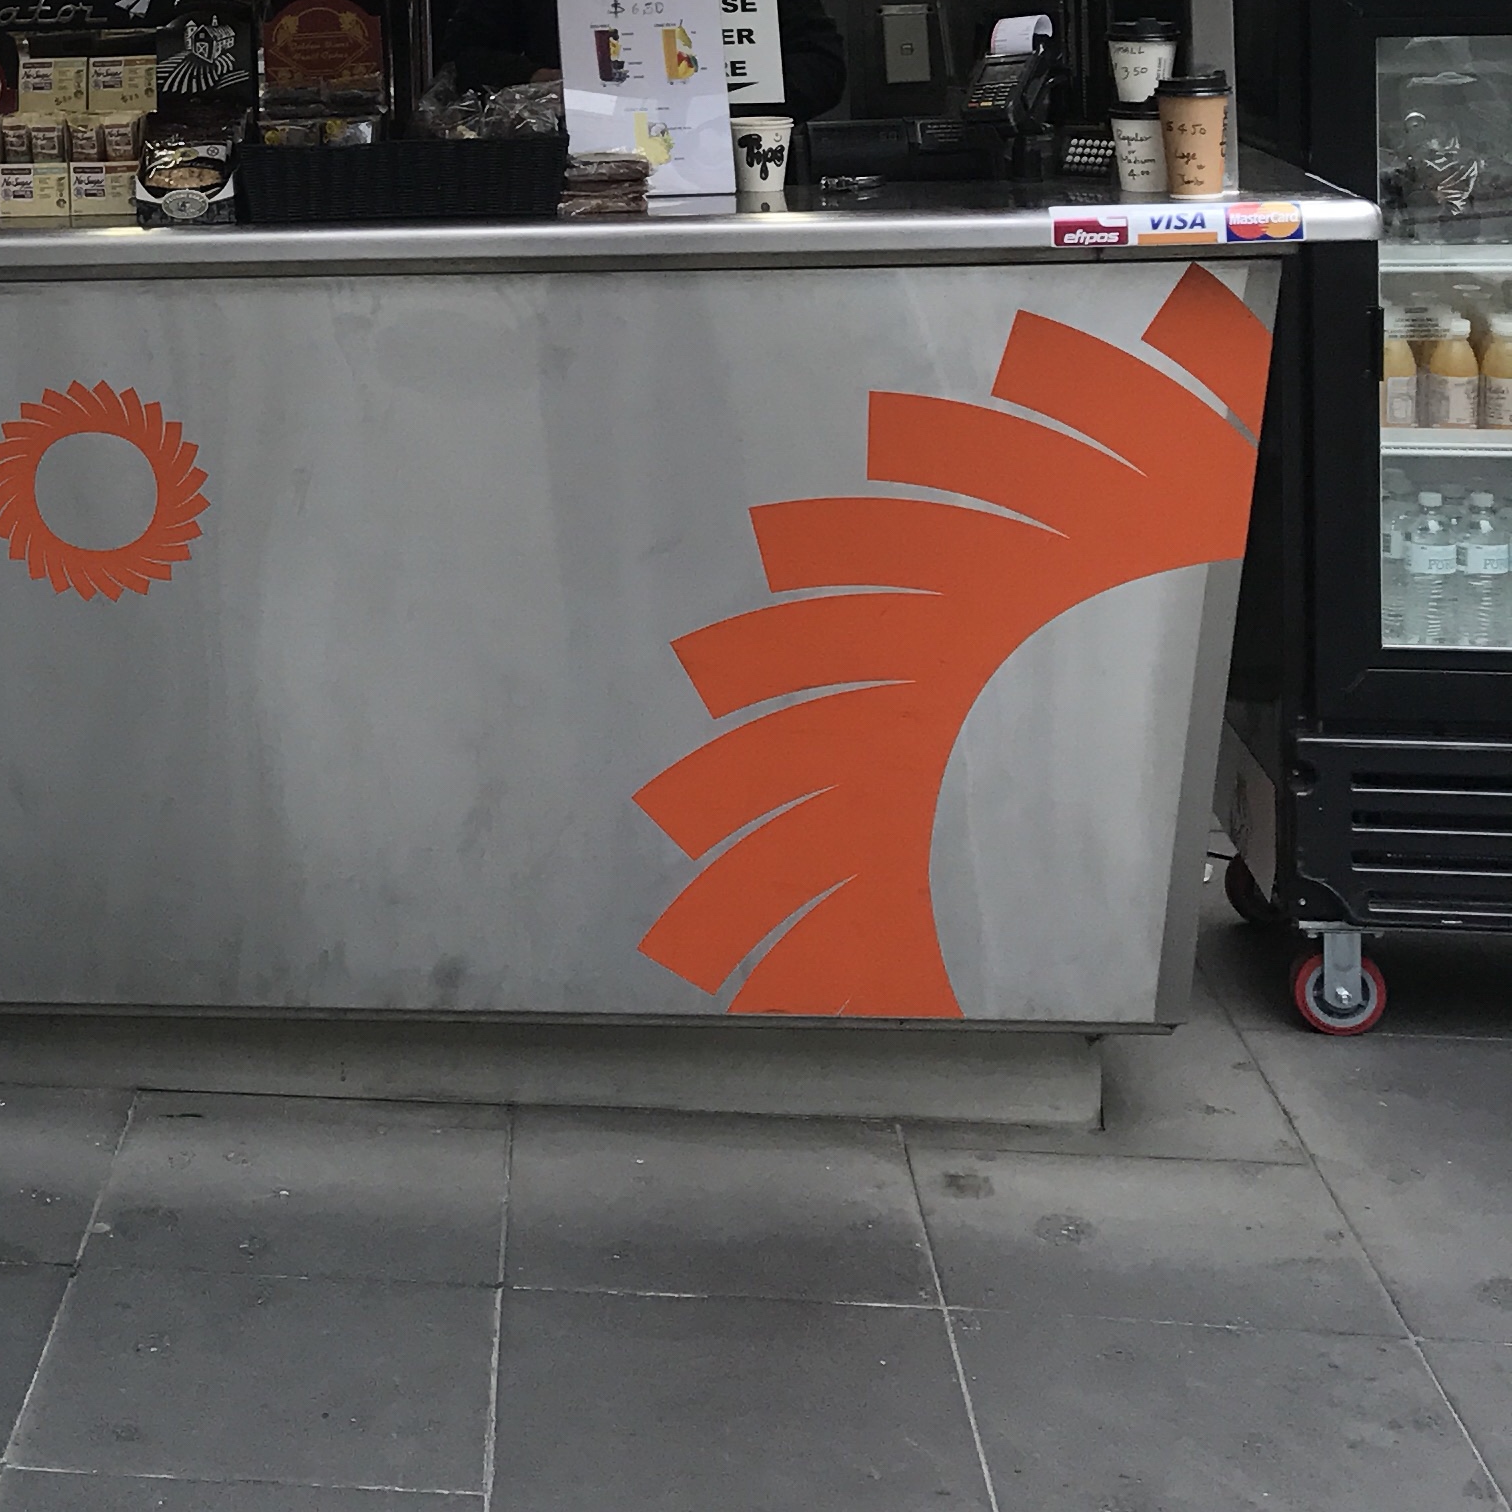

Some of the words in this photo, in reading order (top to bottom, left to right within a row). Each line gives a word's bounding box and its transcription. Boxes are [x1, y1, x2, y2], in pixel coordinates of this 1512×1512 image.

[722, 28, 756, 45] ER
[1117, 129, 1152, 146] Regular
[738, 133, 785, 180] Tips
[1150, 212, 1207, 230] VISA
[1228, 211, 1299, 226] MasterCard
[1063, 230, 1120, 245] eftpos
